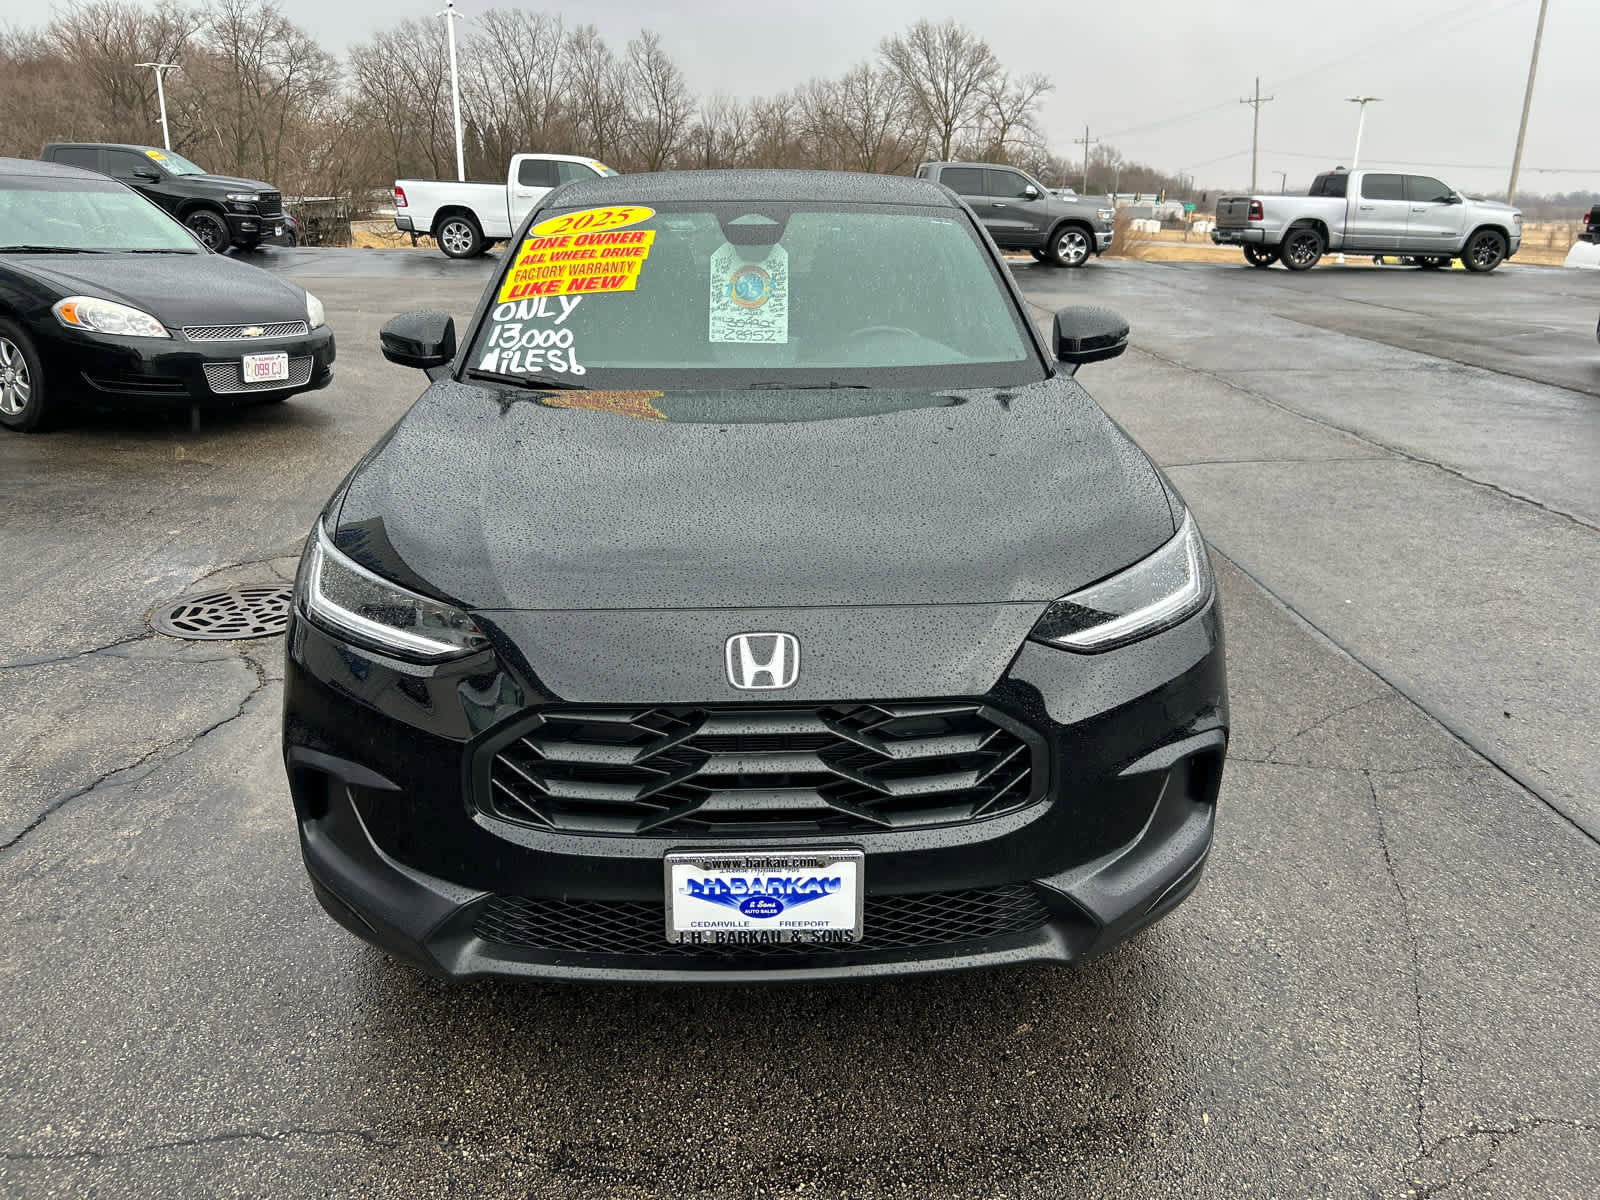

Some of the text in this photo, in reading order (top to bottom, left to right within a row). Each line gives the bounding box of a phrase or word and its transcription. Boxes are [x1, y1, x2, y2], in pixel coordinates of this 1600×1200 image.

[552, 209, 635, 234] 2025
[530, 231, 646, 250] ONE OWNER
[519, 247, 646, 266] ALL WHEEL DRIVE
[514, 260, 635, 283] FACTORY WARRANTY
[508, 275, 627, 299] LIKE NEW
[493, 295, 583, 325] ONLY
[488, 323, 574, 351] 13,000
[712, 855, 818, 869] www.barkau.com
[779, 920, 831, 928] FREEPORT
[715, 930, 781, 944] BARKAU
[790, 929, 801, 943] &
[812, 929, 855, 943] SONS
